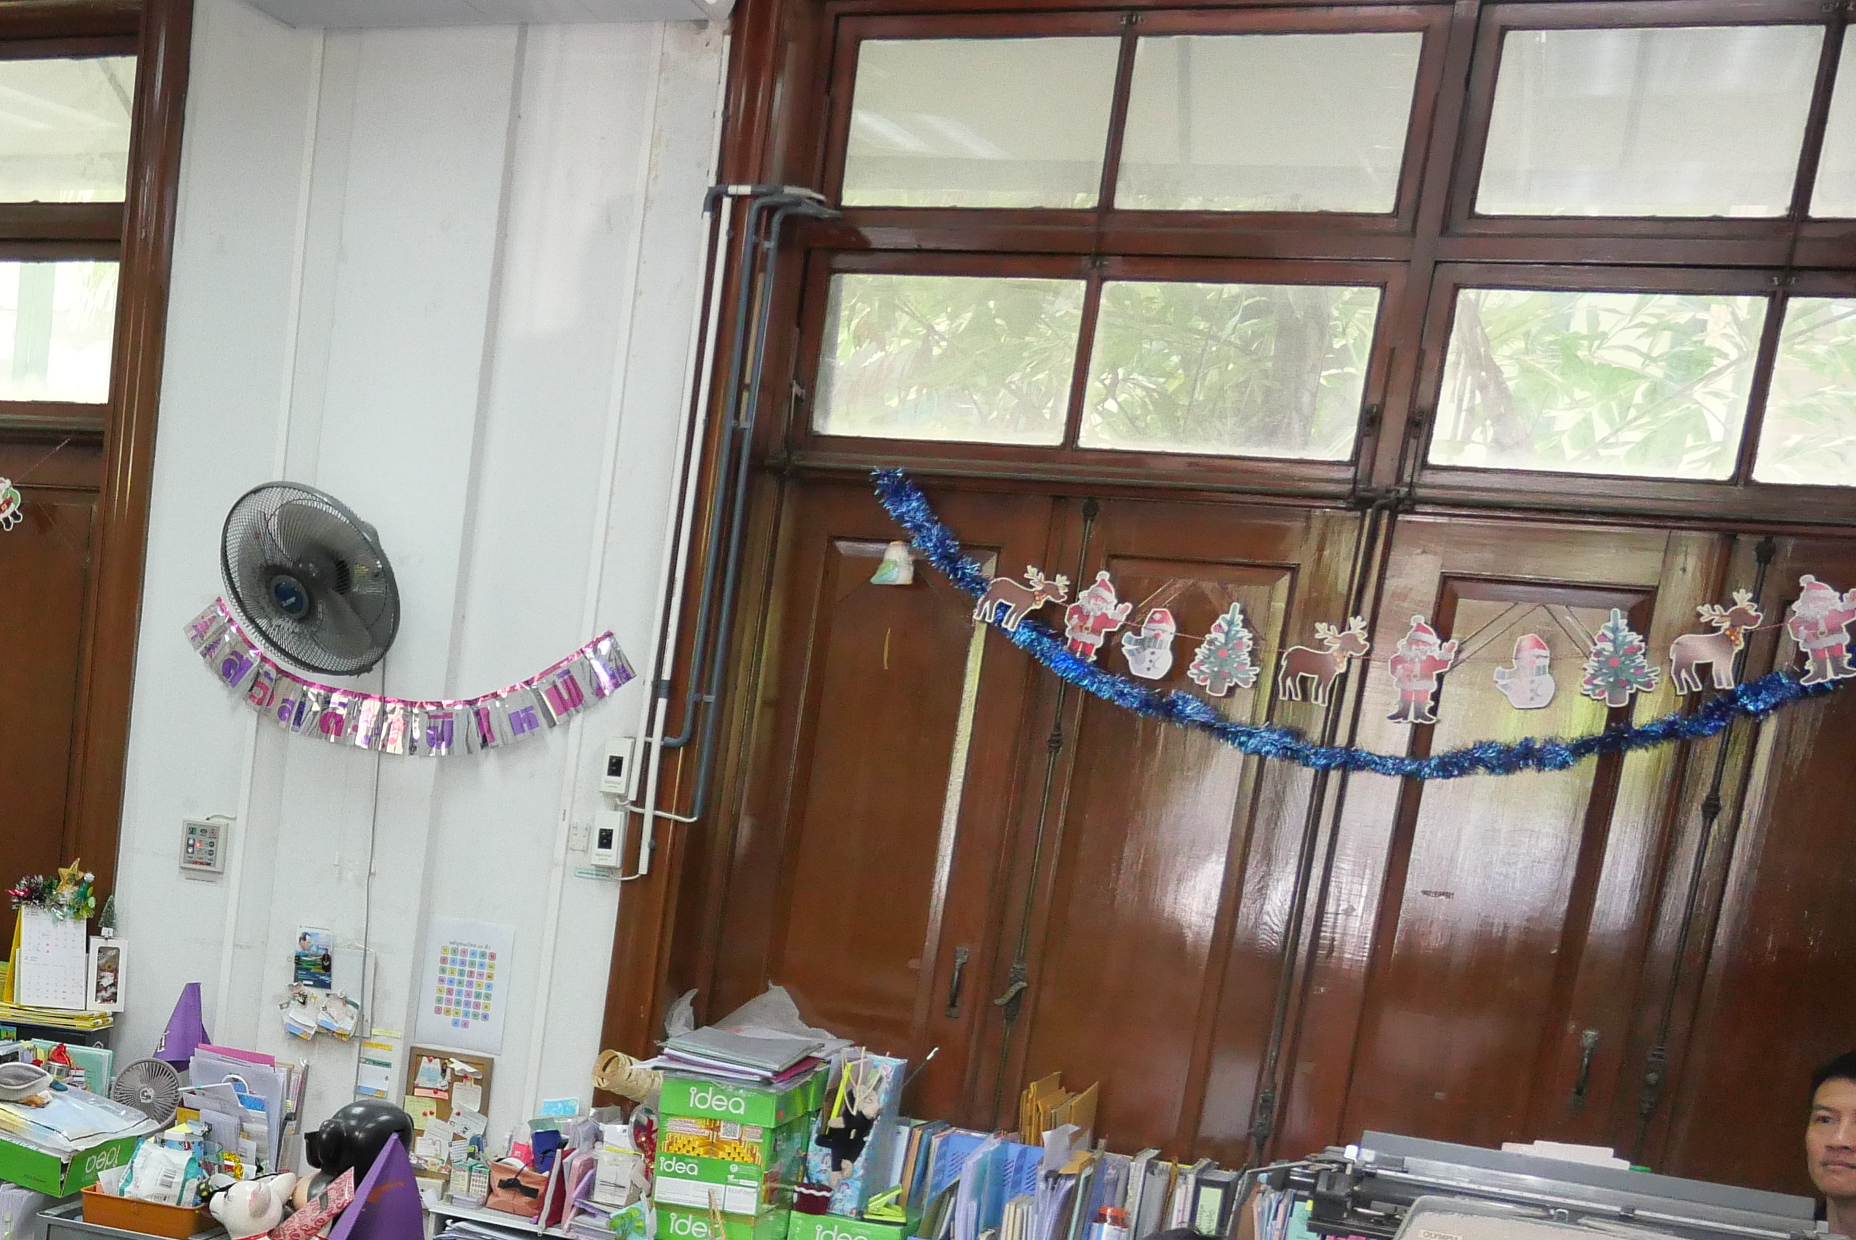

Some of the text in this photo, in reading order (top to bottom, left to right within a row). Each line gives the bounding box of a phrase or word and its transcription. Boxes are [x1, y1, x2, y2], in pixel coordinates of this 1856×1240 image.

[689, 1086, 746, 1115] idea
[84, 1144, 122, 1174] idea
[659, 1157, 699, 1176] idea
